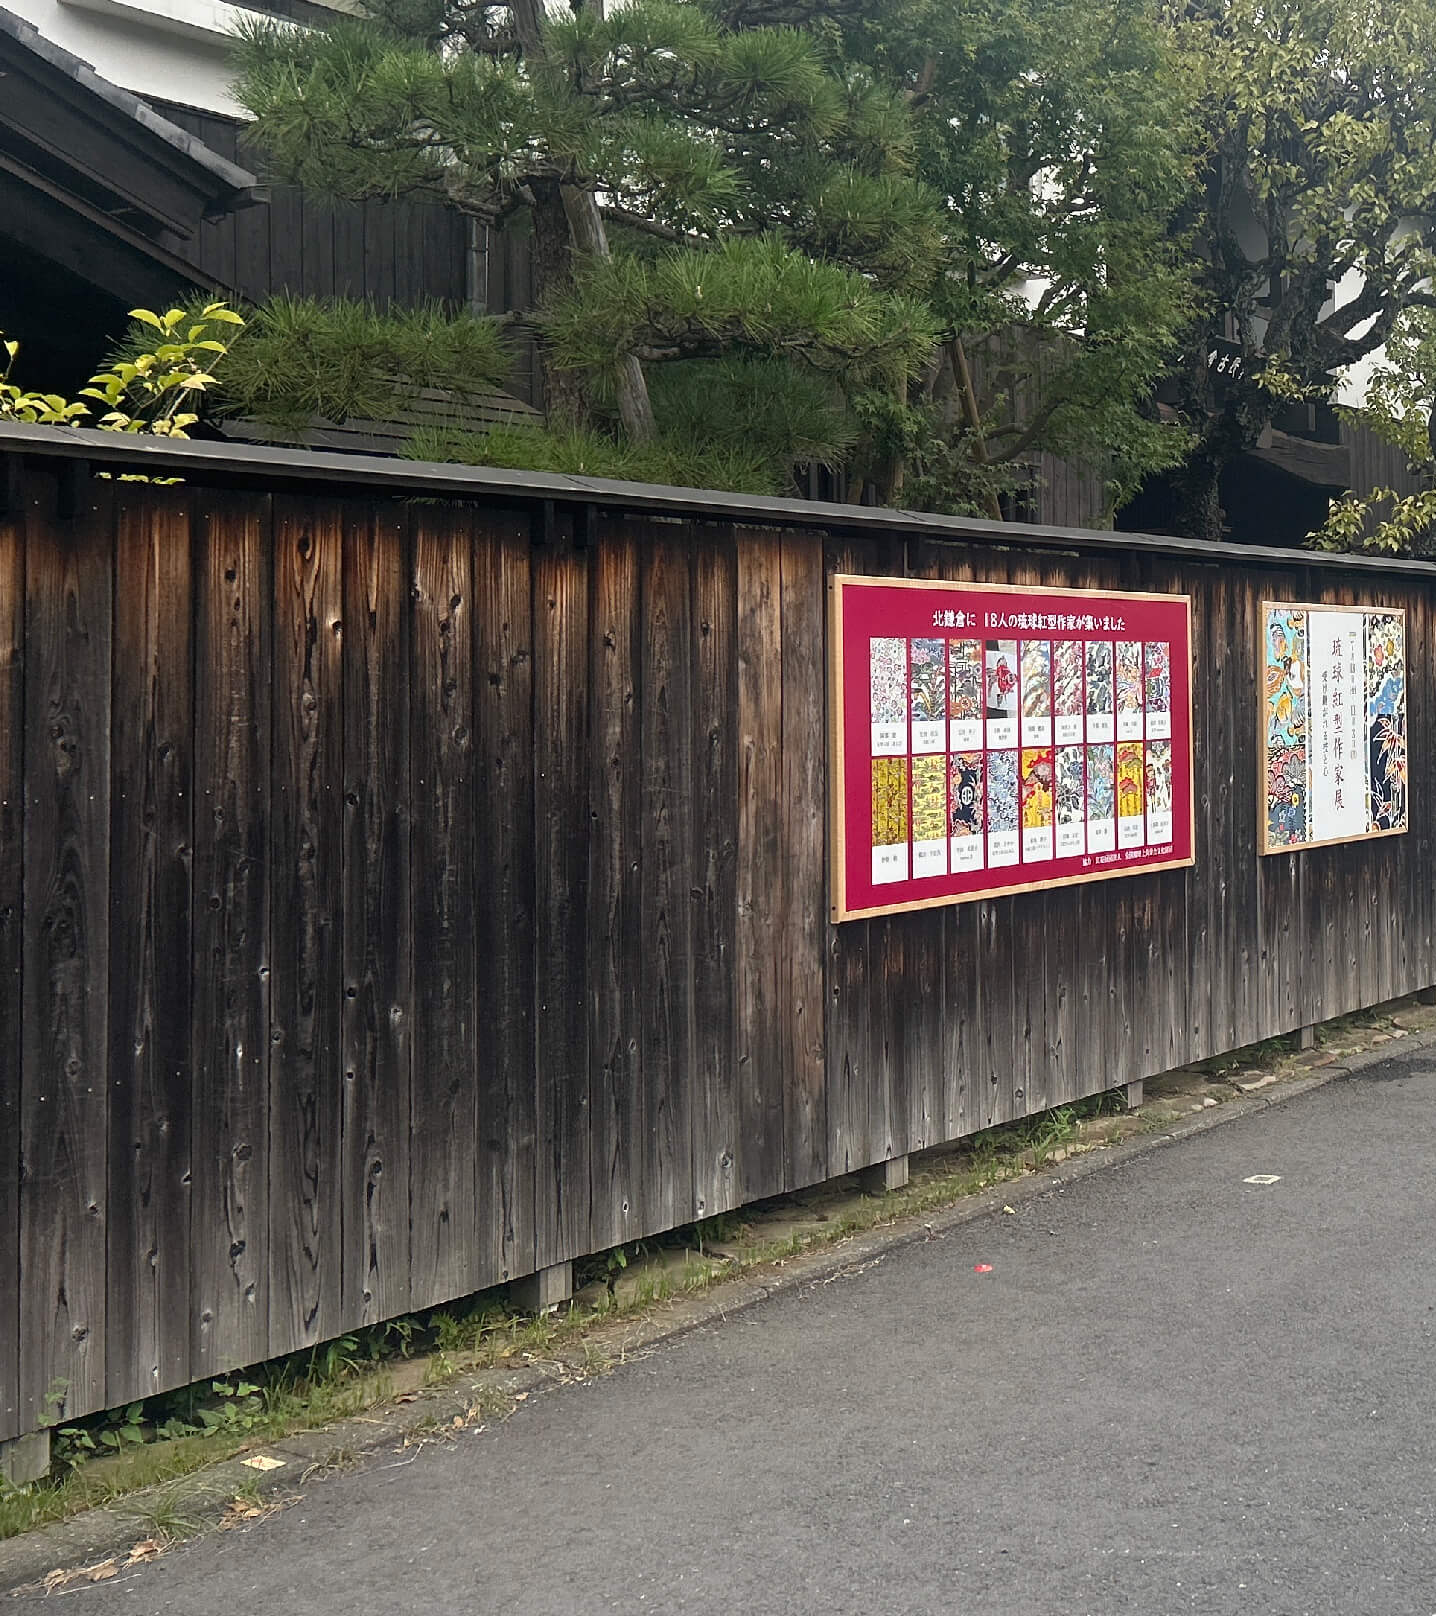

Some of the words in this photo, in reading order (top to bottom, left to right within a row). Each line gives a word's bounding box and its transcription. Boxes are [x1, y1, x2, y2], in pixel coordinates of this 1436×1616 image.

[933, 610, 976, 628] 北鎌倉に
[1331, 636, 1345, 811] 琉球紅型作家展
